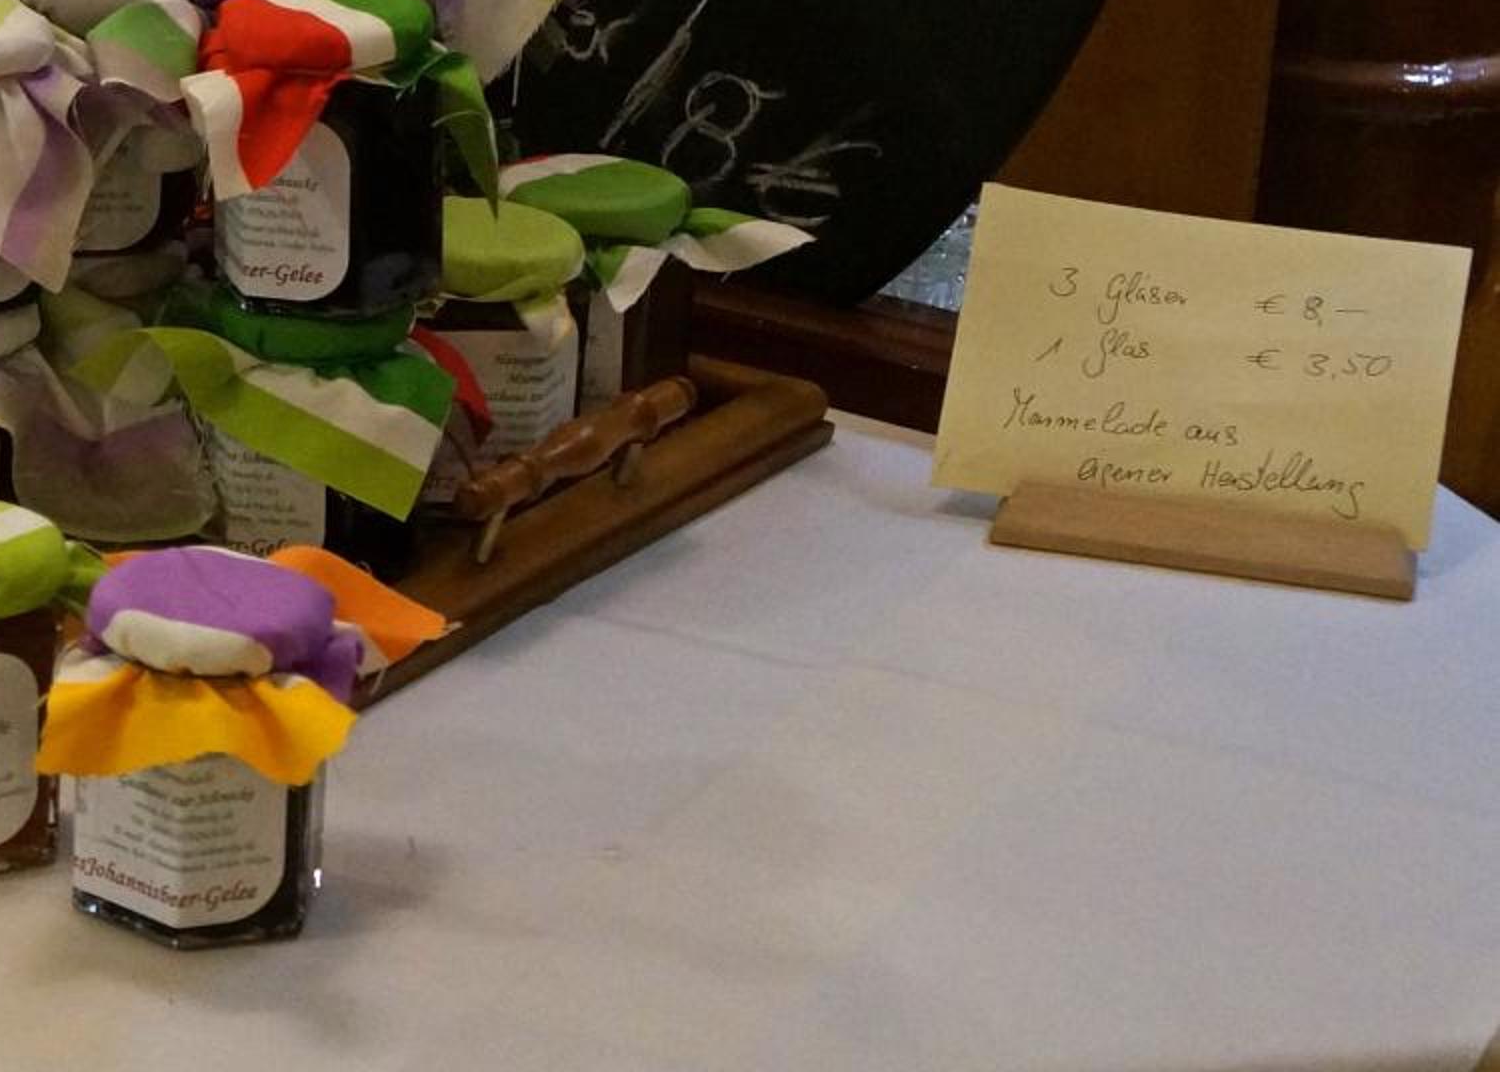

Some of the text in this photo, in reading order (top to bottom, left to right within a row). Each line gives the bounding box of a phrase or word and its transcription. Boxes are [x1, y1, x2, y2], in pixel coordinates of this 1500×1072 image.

[1049, 266, 1079, 297] 3
[1253, 294, 1285, 315] €
[1034, 336, 1064, 362] 1
[1081, 328, 1152, 378] Glas
[1245, 348, 1283, 370] €
[1003, 386, 1239, 446] Marmelade aus
[1201, 447, 1366, 521] Herstellung
